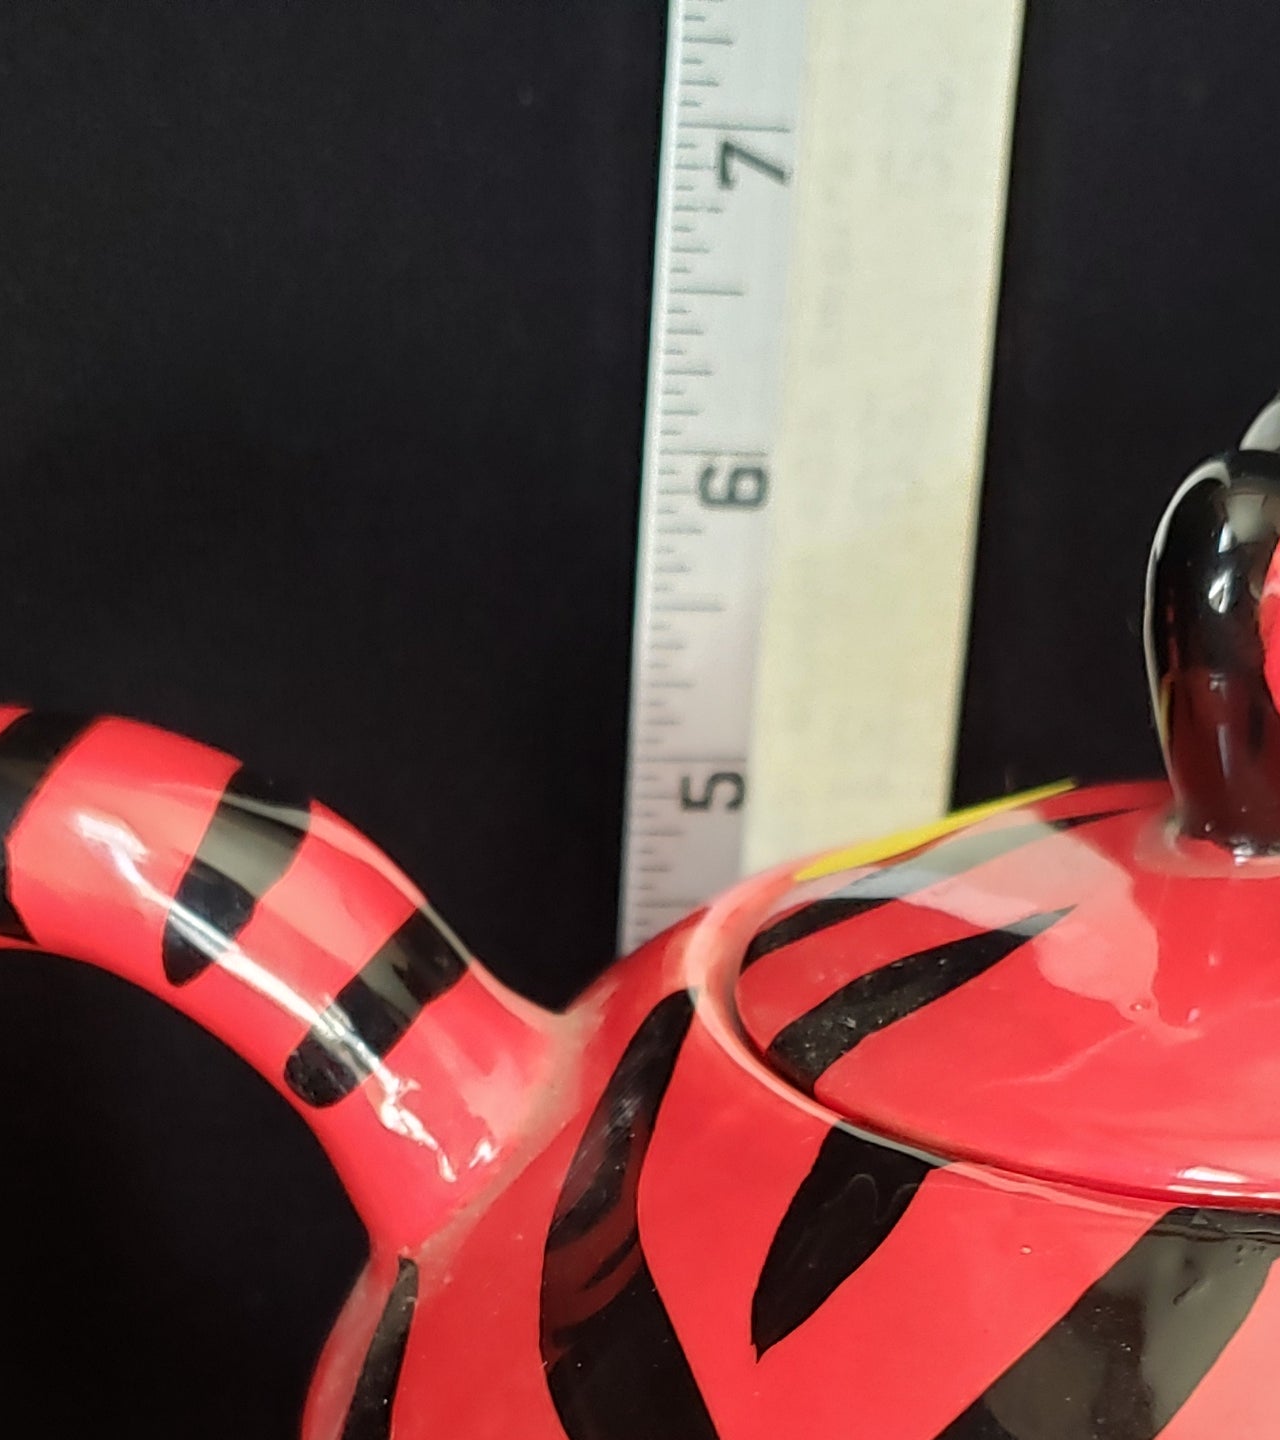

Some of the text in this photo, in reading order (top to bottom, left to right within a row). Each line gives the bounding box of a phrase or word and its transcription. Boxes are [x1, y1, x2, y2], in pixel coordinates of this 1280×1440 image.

[718, 141, 790, 189] 7
[699, 465, 767, 509] 6
[681, 772, 745, 811] 5
